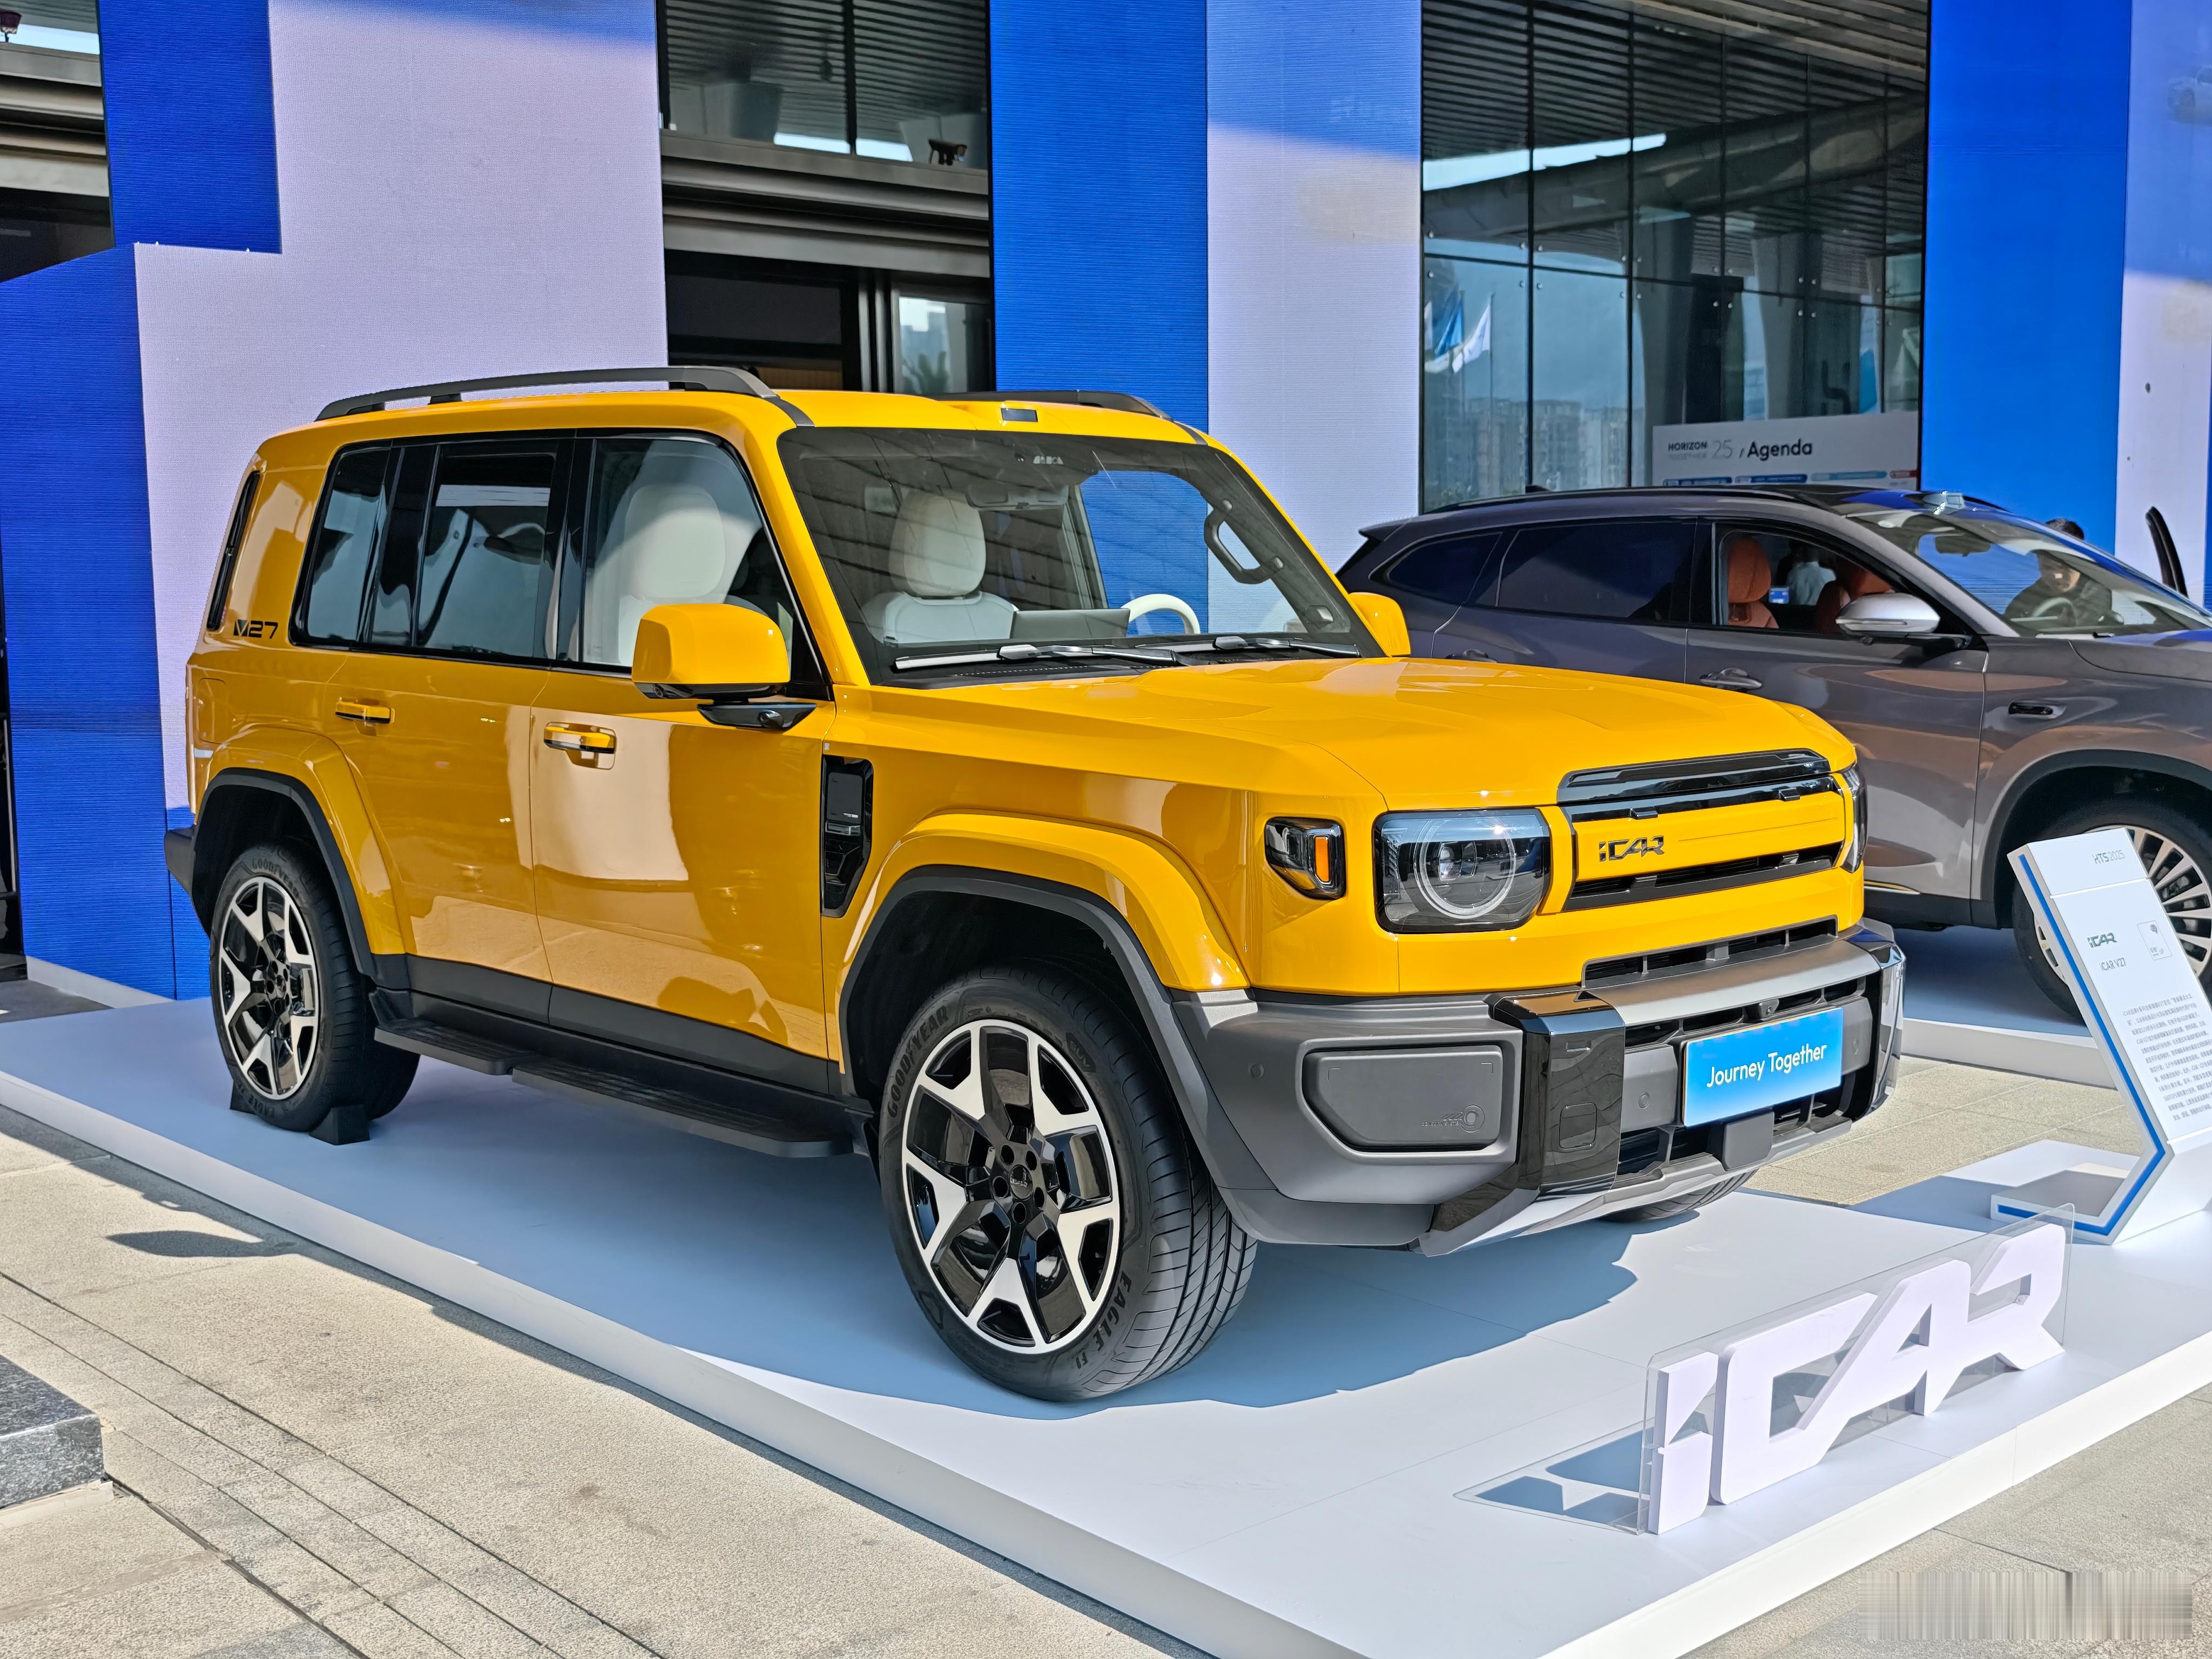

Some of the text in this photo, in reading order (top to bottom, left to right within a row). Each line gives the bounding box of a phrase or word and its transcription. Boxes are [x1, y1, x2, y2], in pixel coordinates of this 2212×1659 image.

[1668, 441, 1707, 451] HORIZON
[1711, 440, 1732, 459] 25
[1747, 438, 1813, 461] Agenda
[233, 619, 279, 639] V27
[2099, 957, 2126, 972] iCAR V27
[887, 1005, 949, 1118] GOODYEAR
[1705, 1043, 1827, 1088] Journey Together
[1092, 1270, 1132, 1352] EAGLE
